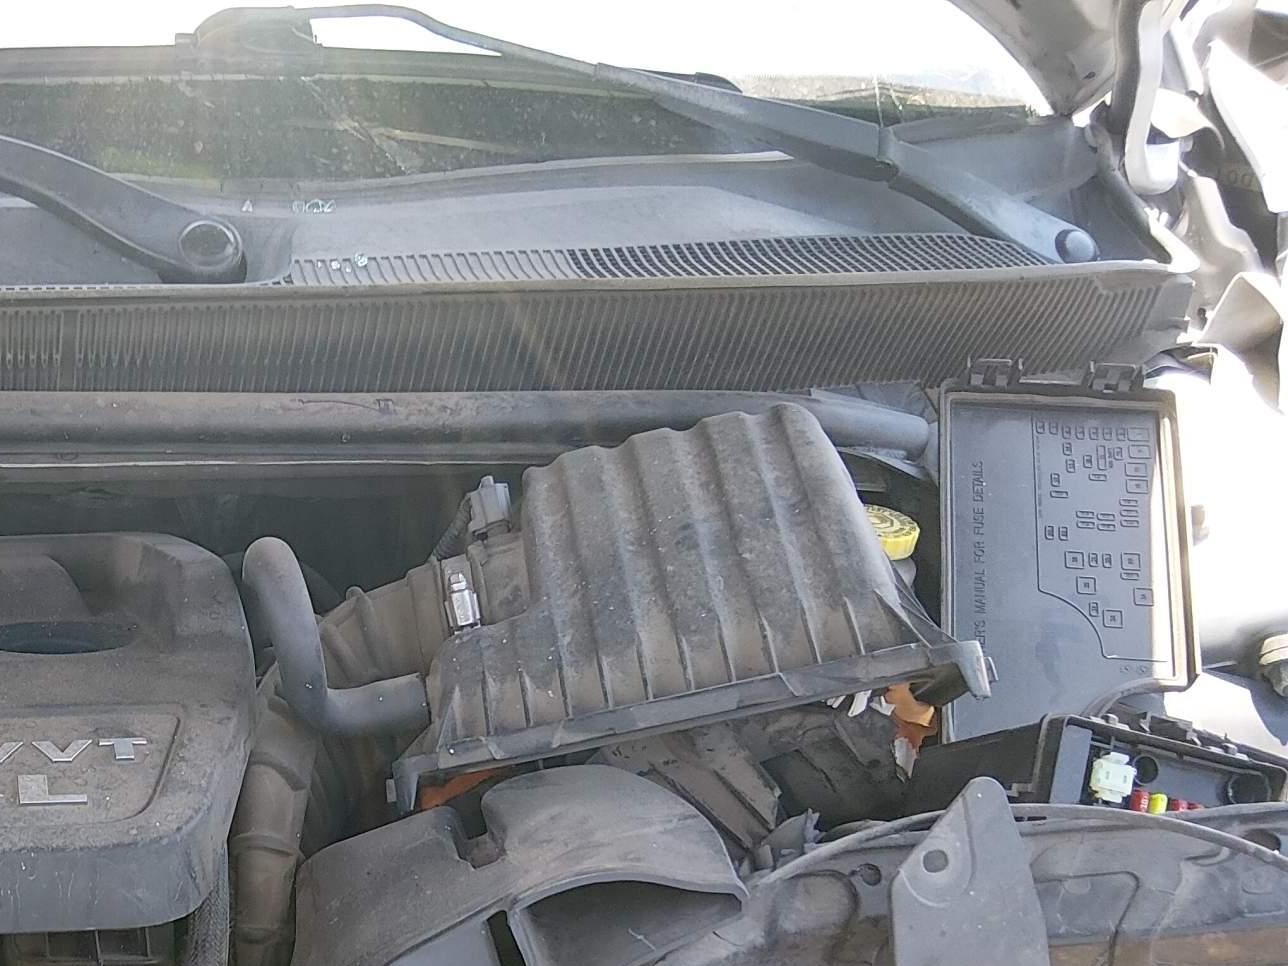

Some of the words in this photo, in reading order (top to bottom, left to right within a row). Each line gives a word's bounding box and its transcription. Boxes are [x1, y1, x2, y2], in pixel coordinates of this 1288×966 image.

[971, 460, 985, 503] DETAILS
[972, 507, 985, 536] FUSE
[973, 541, 986, 564] FOR
[973, 568, 986, 614] MANUAL
